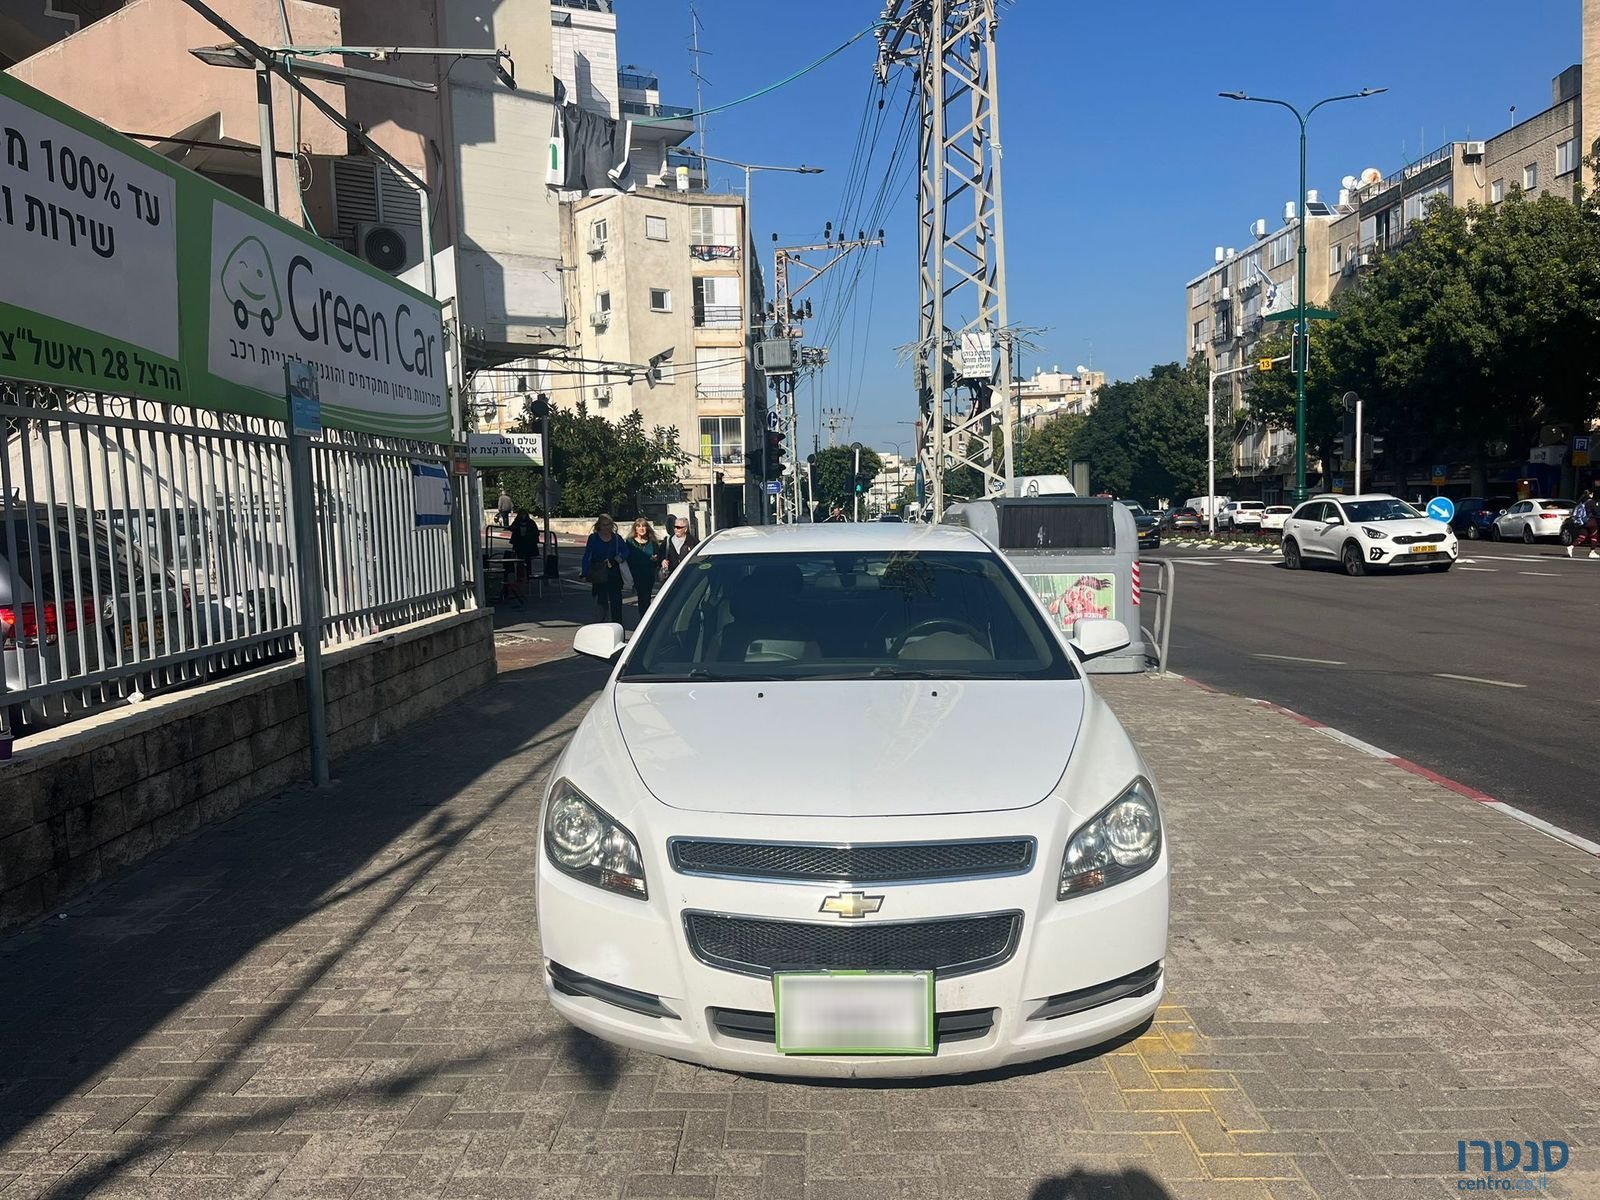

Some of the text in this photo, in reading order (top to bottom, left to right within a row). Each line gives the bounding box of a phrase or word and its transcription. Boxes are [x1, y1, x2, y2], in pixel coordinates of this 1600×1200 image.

[0, 127, 161, 226] עד 100% מ
[24, 194, 115, 259] שירות
[287, 255, 436, 379] Green Car
[229, 338, 257, 362] רכב
[102, 347, 129, 382] 28
[134, 352, 181, 391] הרצל
[1261, 360, 1270, 368] 13
[349, 371, 389, 396] מתקדמים
[391, 383, 412, 401] מימון
[480, 446, 499, 456] קצת
[501, 446, 511, 454] זה
[513, 446, 538, 454] אצלנו
[517, 436, 537, 445] שלם
